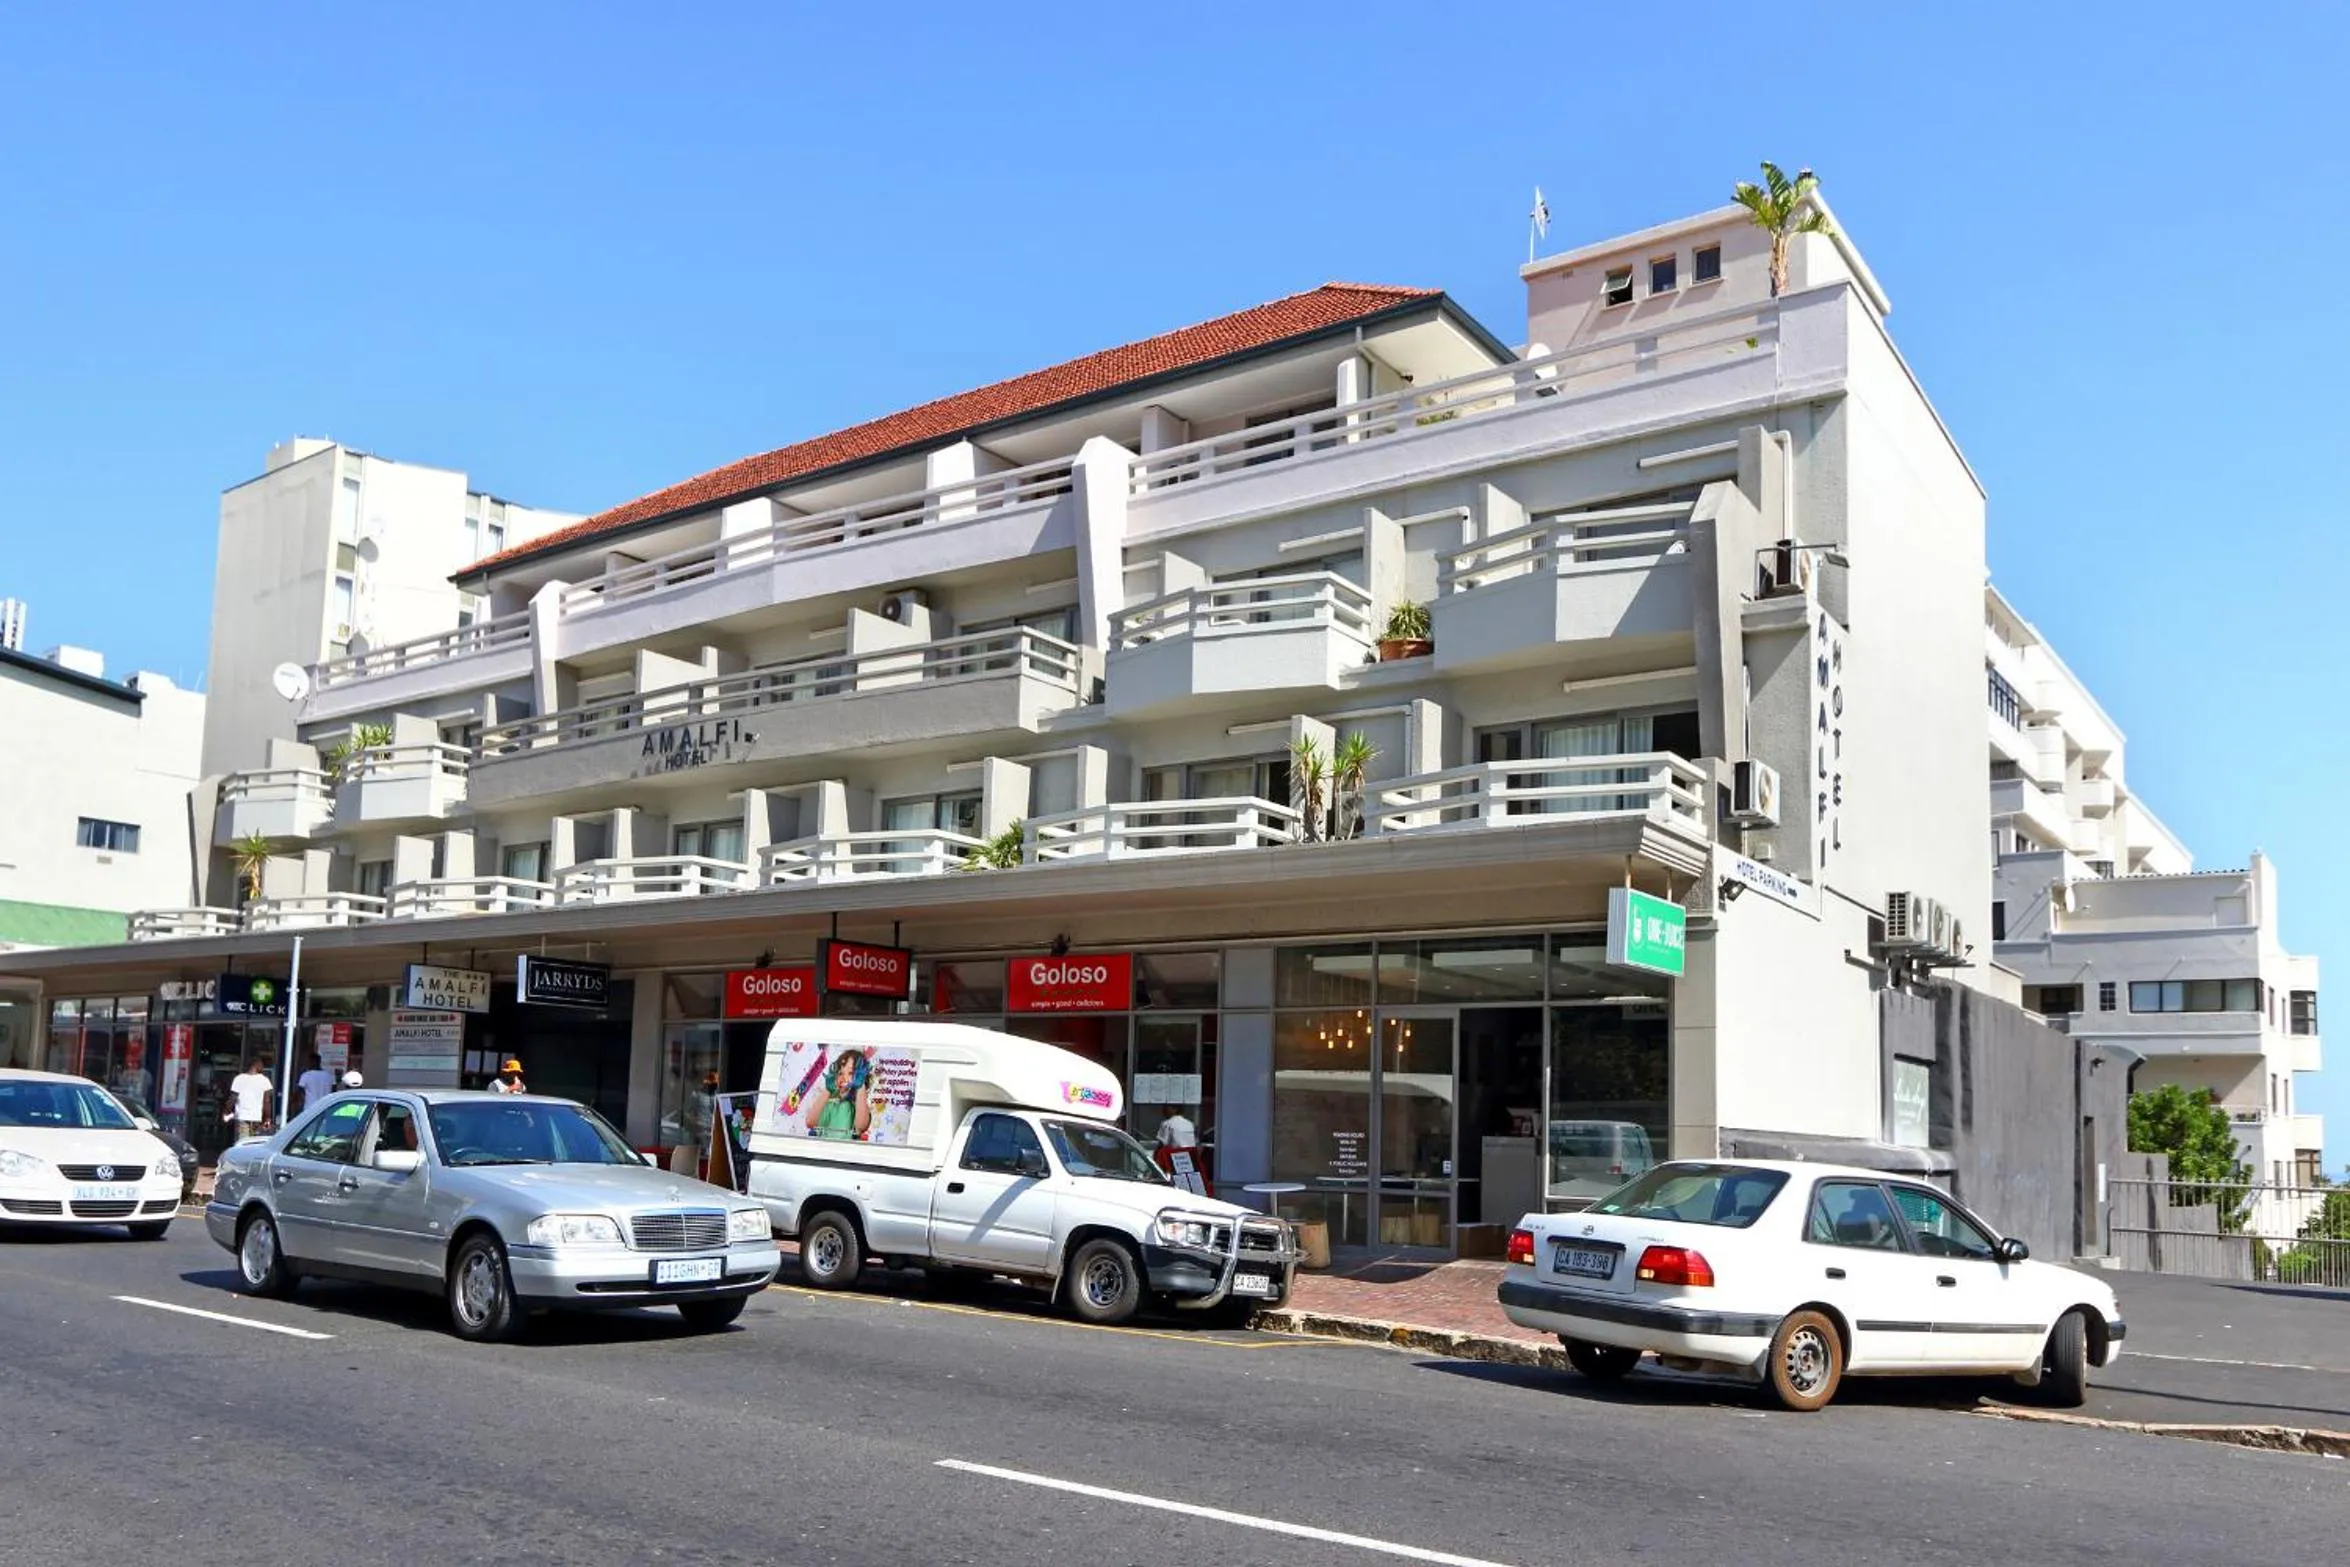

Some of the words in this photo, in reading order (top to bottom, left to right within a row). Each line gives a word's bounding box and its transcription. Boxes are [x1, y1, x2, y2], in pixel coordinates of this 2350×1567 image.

[641, 719, 739, 757] AMALFI
[1816, 611, 1829, 869] AMALFI
[1831, 638, 1844, 851] HOTEL
[665, 747, 707, 770] HOTEL
[1736, 859, 1758, 882] HOTEL
[1759, 869, 1787, 896] PARKING
[839, 949, 898, 973] Goloso
[443, 970, 460, 978] THE
[533, 970, 605, 991] JARRYDS
[743, 975, 802, 995] Goloso
[1030, 962, 1107, 985] Goloso
[415, 977, 486, 995] AMALFI
[226, 1001, 287, 1016] CLICK
[423, 993, 474, 1010] HOTEL
